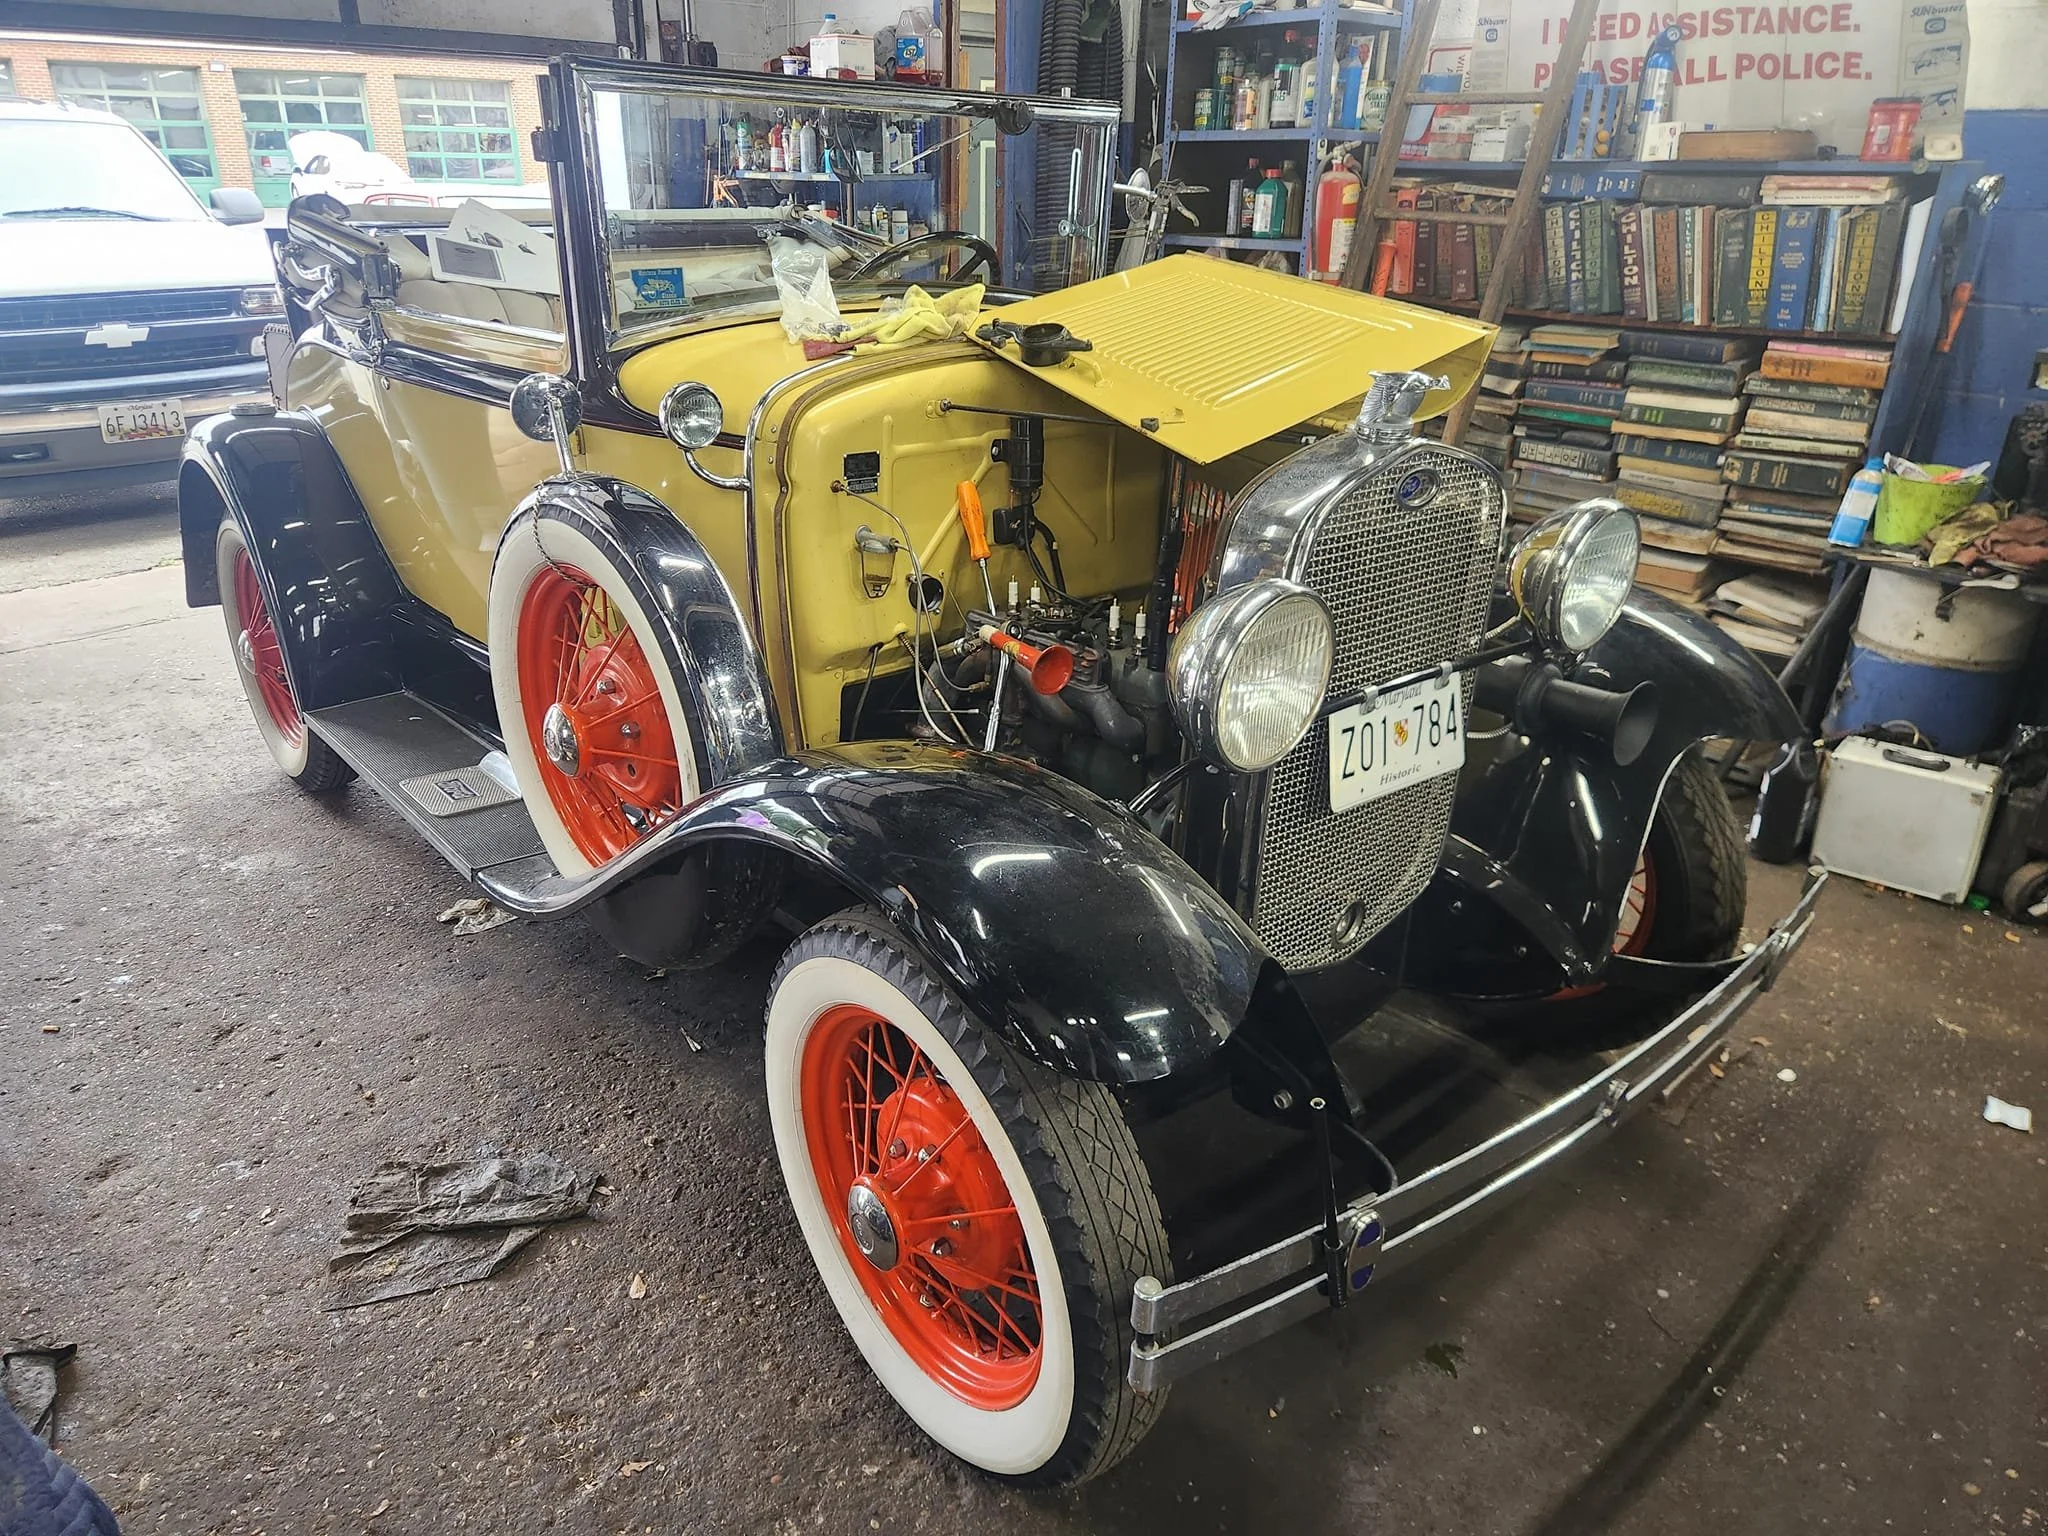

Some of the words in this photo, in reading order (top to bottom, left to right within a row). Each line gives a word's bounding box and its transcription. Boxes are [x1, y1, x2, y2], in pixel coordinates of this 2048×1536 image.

[1542, 18, 1550, 45] I
[1647, 4, 1860, 41] ASSISTANCE.
[1735, 51, 1872, 80] POLICE.
[1620, 212, 1640, 286] CHILTON
[1684, 208, 1692, 256] CHILTON
[1755, 213, 1770, 288] CHILTON
[1851, 213, 1872, 293] CHILTON
[1520, 446, 1578, 464] CHILTON
[1413, 692, 1457, 756] 784
[1380, 763, 1422, 786] Historic
